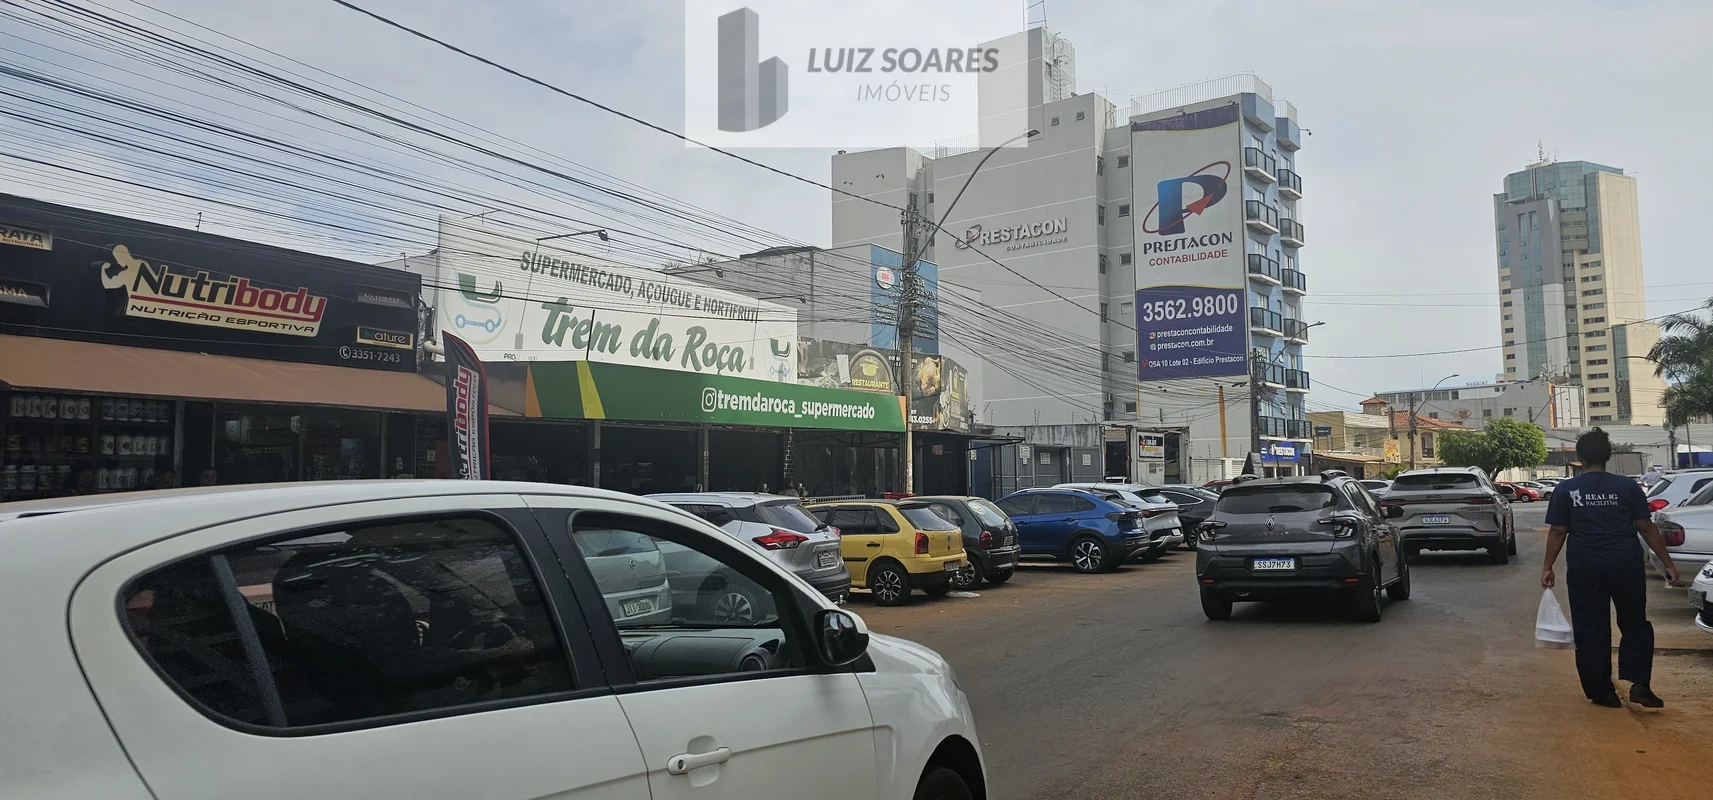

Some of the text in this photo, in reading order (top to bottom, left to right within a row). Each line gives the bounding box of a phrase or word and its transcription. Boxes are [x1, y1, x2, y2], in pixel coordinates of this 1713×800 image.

[1006, 237, 1068, 251] CONTABILIDADE
[1143, 231, 1233, 254] PRESTACON
[1148, 249, 1228, 266] CONTABILIDADE
[132, 262, 322, 323] Nutribody
[637, 279, 692, 309] AÇOUGUE
[693, 294, 701, 311] E
[703, 297, 759, 325] HORTIFRUTI
[1143, 293, 1238, 322] 3562.9800
[130, 304, 315, 333] NUTRIÇÃO ESPORTIVA
[541, 296, 748, 375] Trem da Roça
[1156, 323, 1233, 340] prestaconcontabilidade
[1157, 337, 1214, 351] prestacon.com.br
[351, 349, 400, 363] 3351-7243
[1215, 355, 1244, 363] Prestacon
[851, 378, 890, 390] RESTAURANTE
[717, 389, 875, 419] tremdaroca_supermercado
